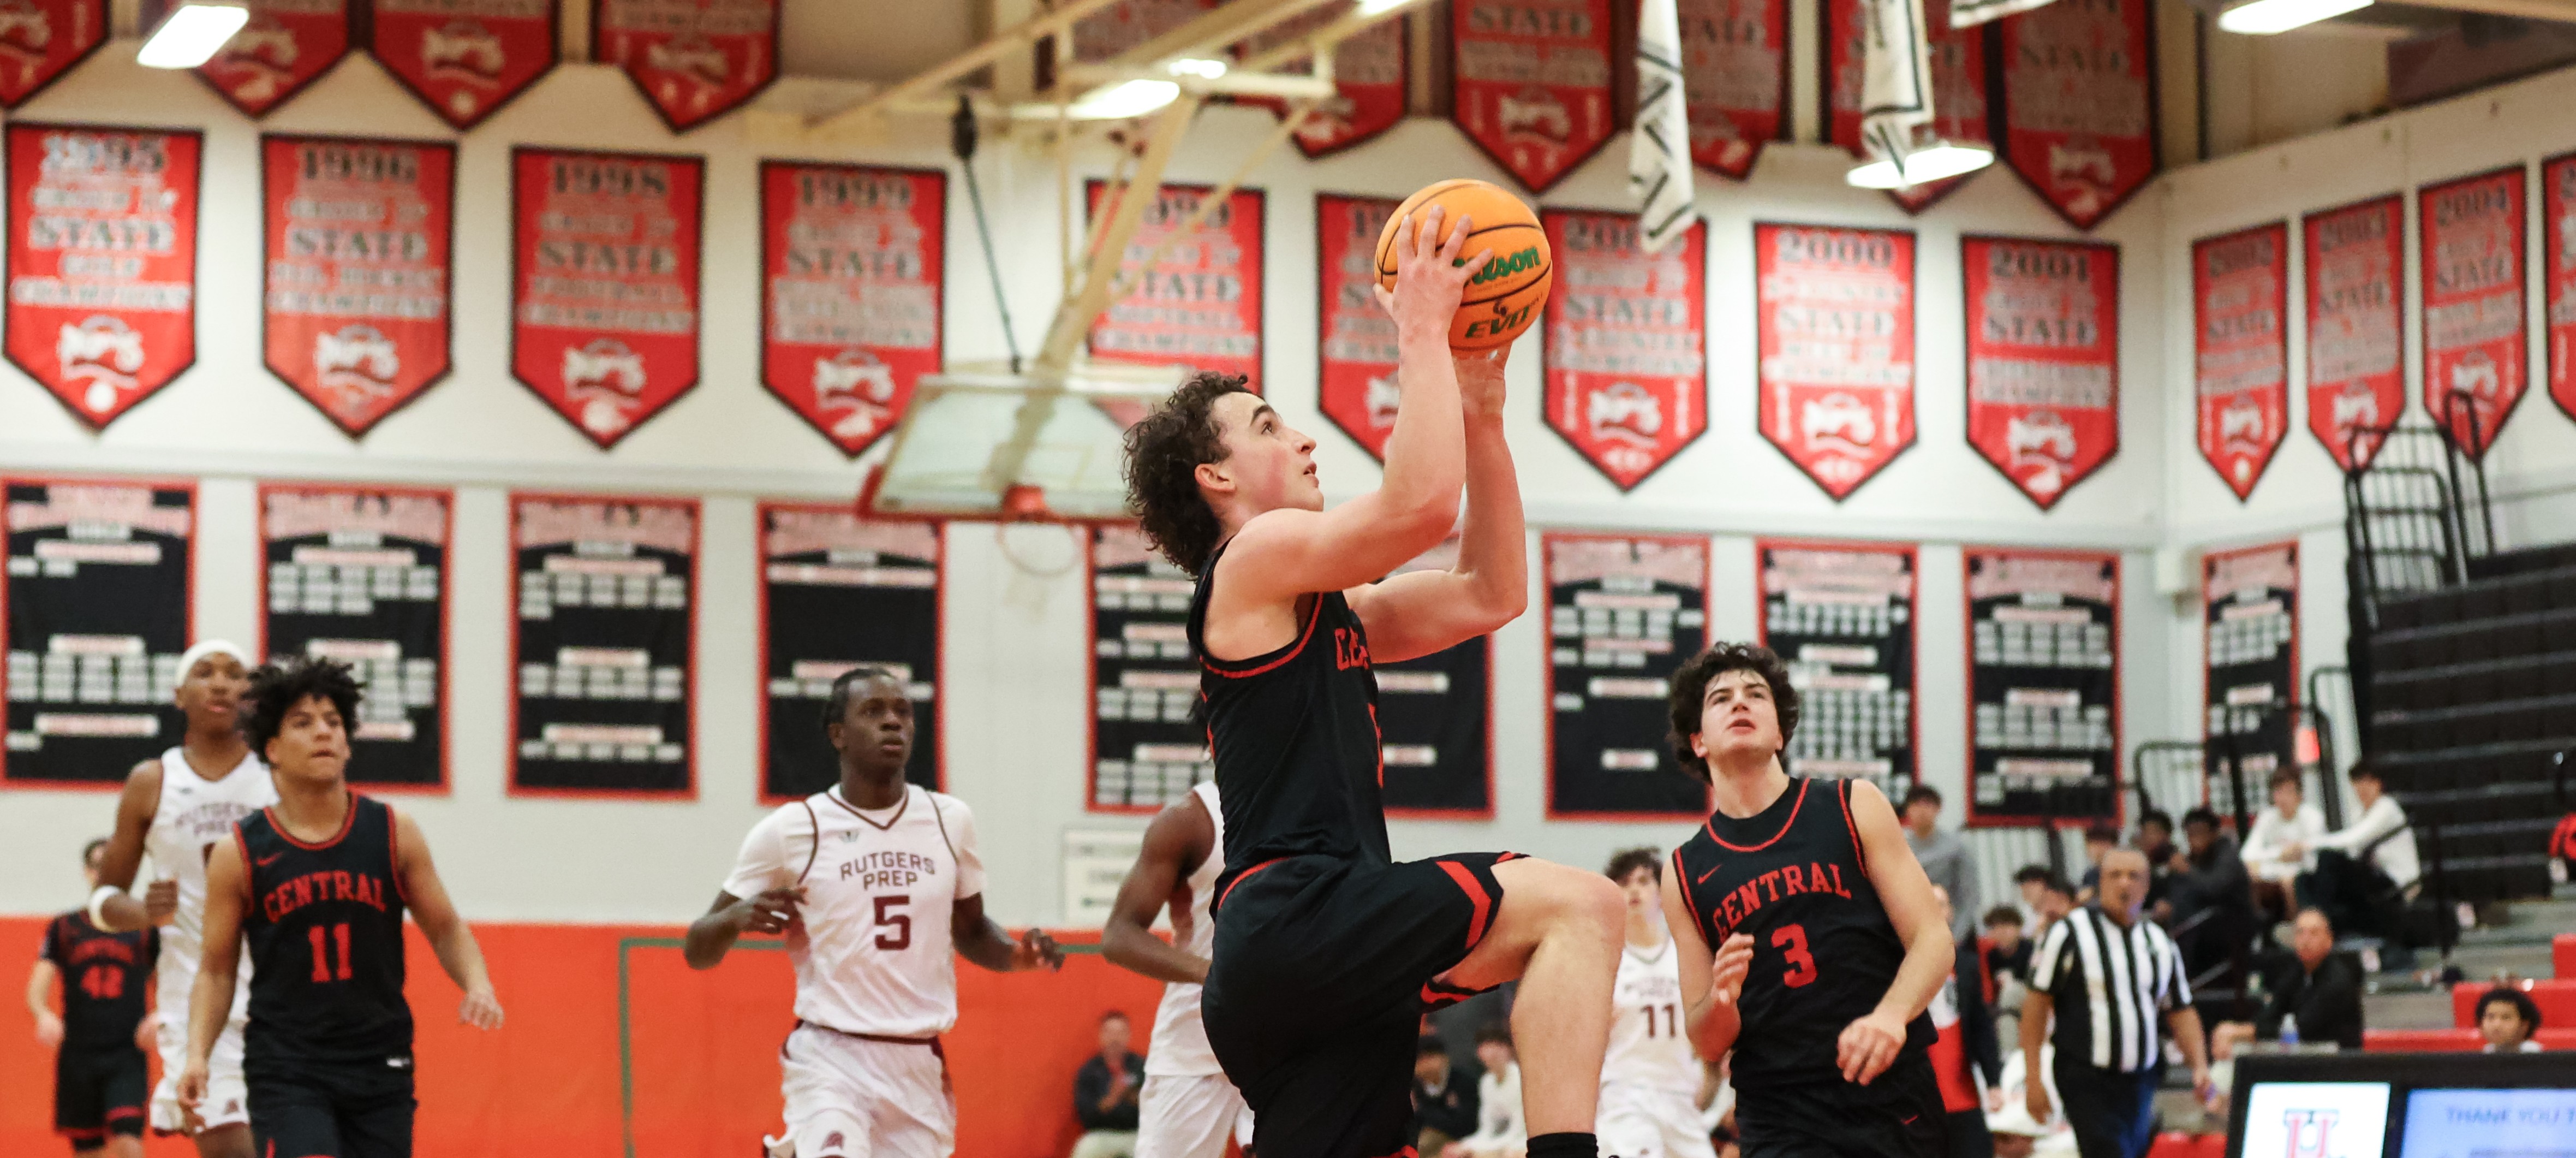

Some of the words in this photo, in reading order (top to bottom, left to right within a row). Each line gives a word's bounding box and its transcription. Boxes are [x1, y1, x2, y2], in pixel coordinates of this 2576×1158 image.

[302, 147, 418, 183] 1996
[553, 164, 669, 195] 1998
[798, 176, 911, 207] 1999
[32, 219, 174, 250] STATE
[290, 229, 428, 259] STATE
[1777, 232, 1894, 267] 2000
[540, 242, 677, 275] STATE
[789, 248, 921, 281] STATE
[1989, 246, 2089, 281] 2001
[1564, 296, 1685, 326] STATE
[1779, 309, 1894, 336] STATE
[1987, 318, 2097, 345] STATE
[840, 851, 935, 881] RUTGERS
[863, 870, 918, 891] PREP
[264, 871, 386, 923] CENTRAL
[1713, 862, 1851, 943] CENTRAL
[873, 894, 911, 950] 5
[308, 923, 352, 982] 11
[1771, 923, 1817, 988] 3
[1641, 1004, 1676, 1038] 11
